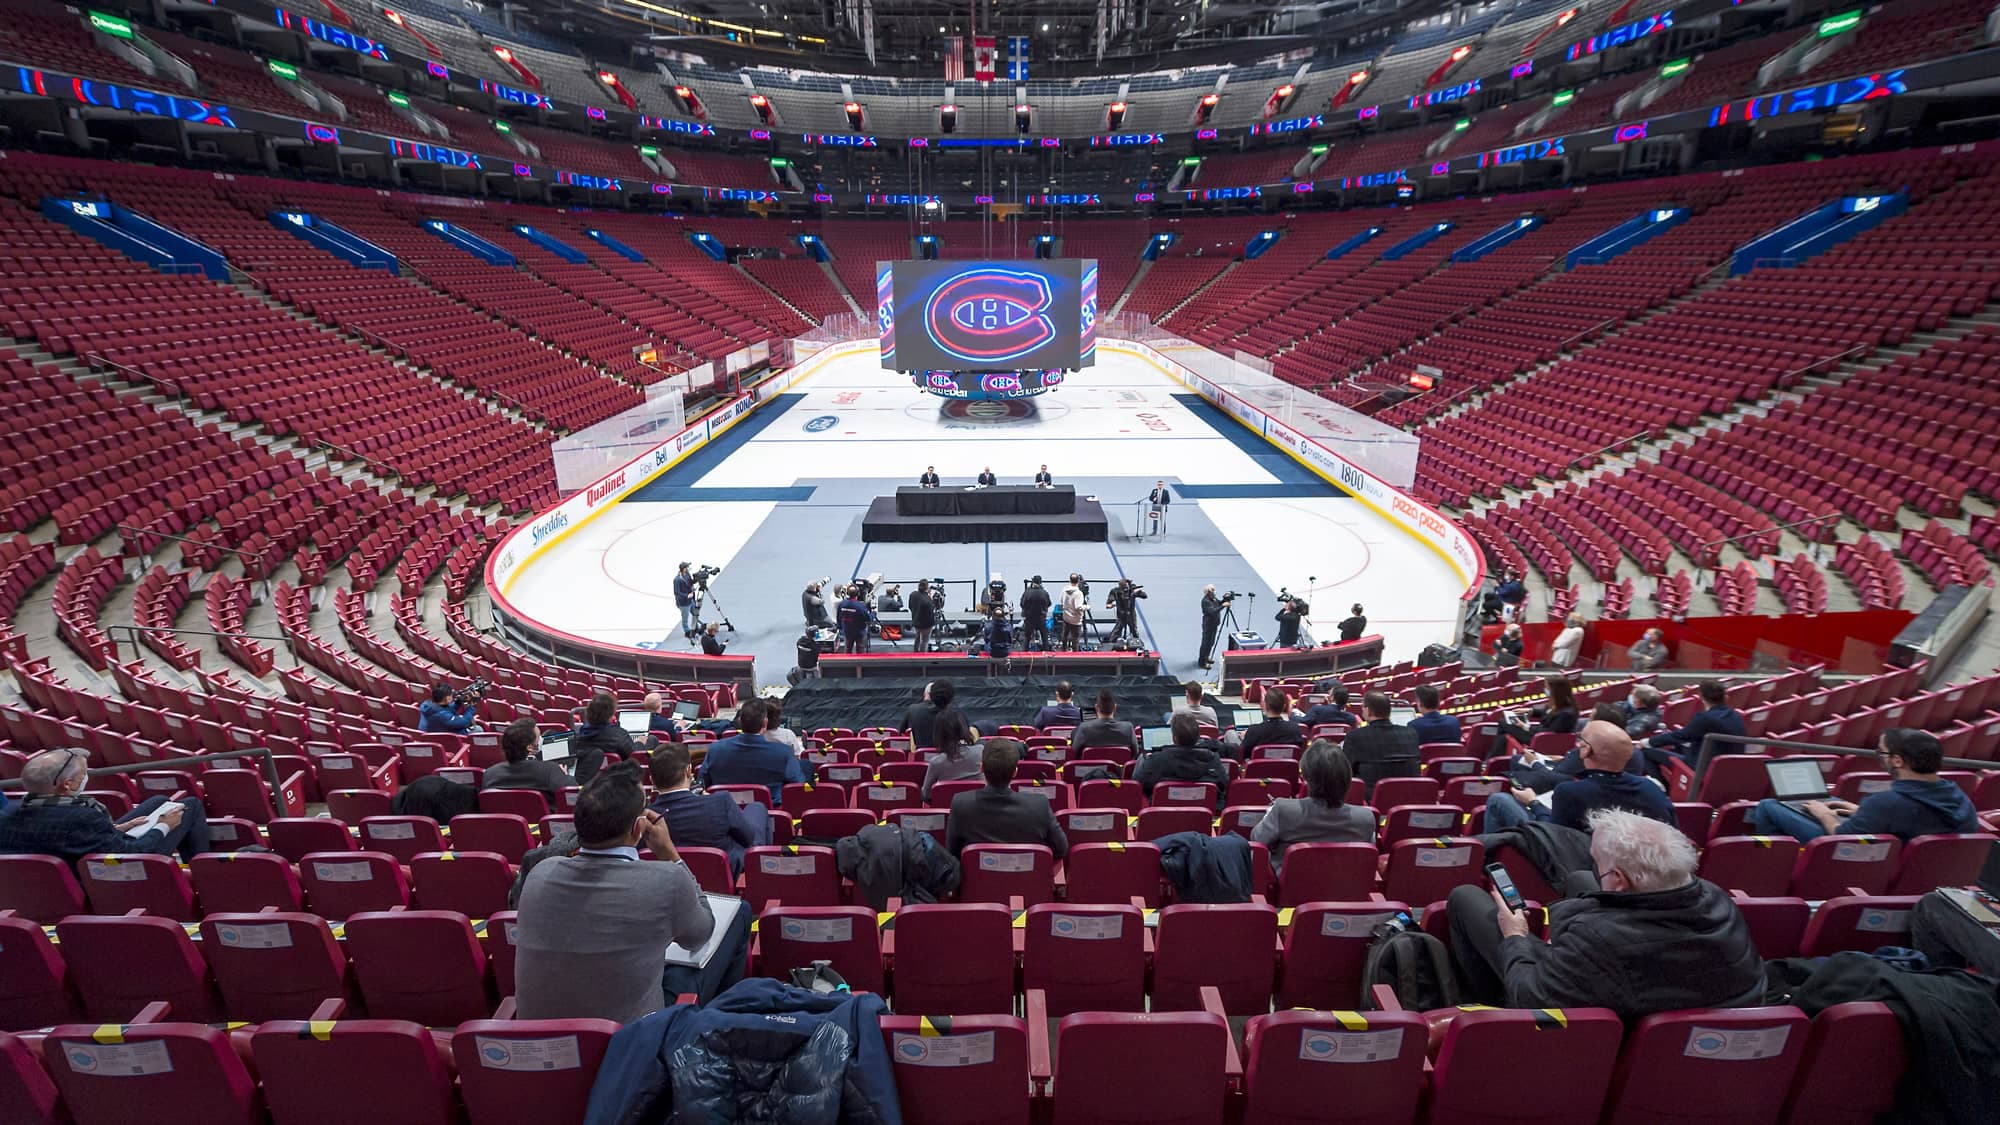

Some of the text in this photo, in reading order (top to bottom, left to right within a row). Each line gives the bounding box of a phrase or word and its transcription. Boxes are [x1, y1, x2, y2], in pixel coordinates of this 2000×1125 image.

[656, 448, 668, 467] Bell
[586, 470, 626, 507] Qualinet
[1341, 463, 1364, 491] 1800
[531, 510, 568, 546] Shreddies
[1392, 495, 1447, 539] pizza pizza
